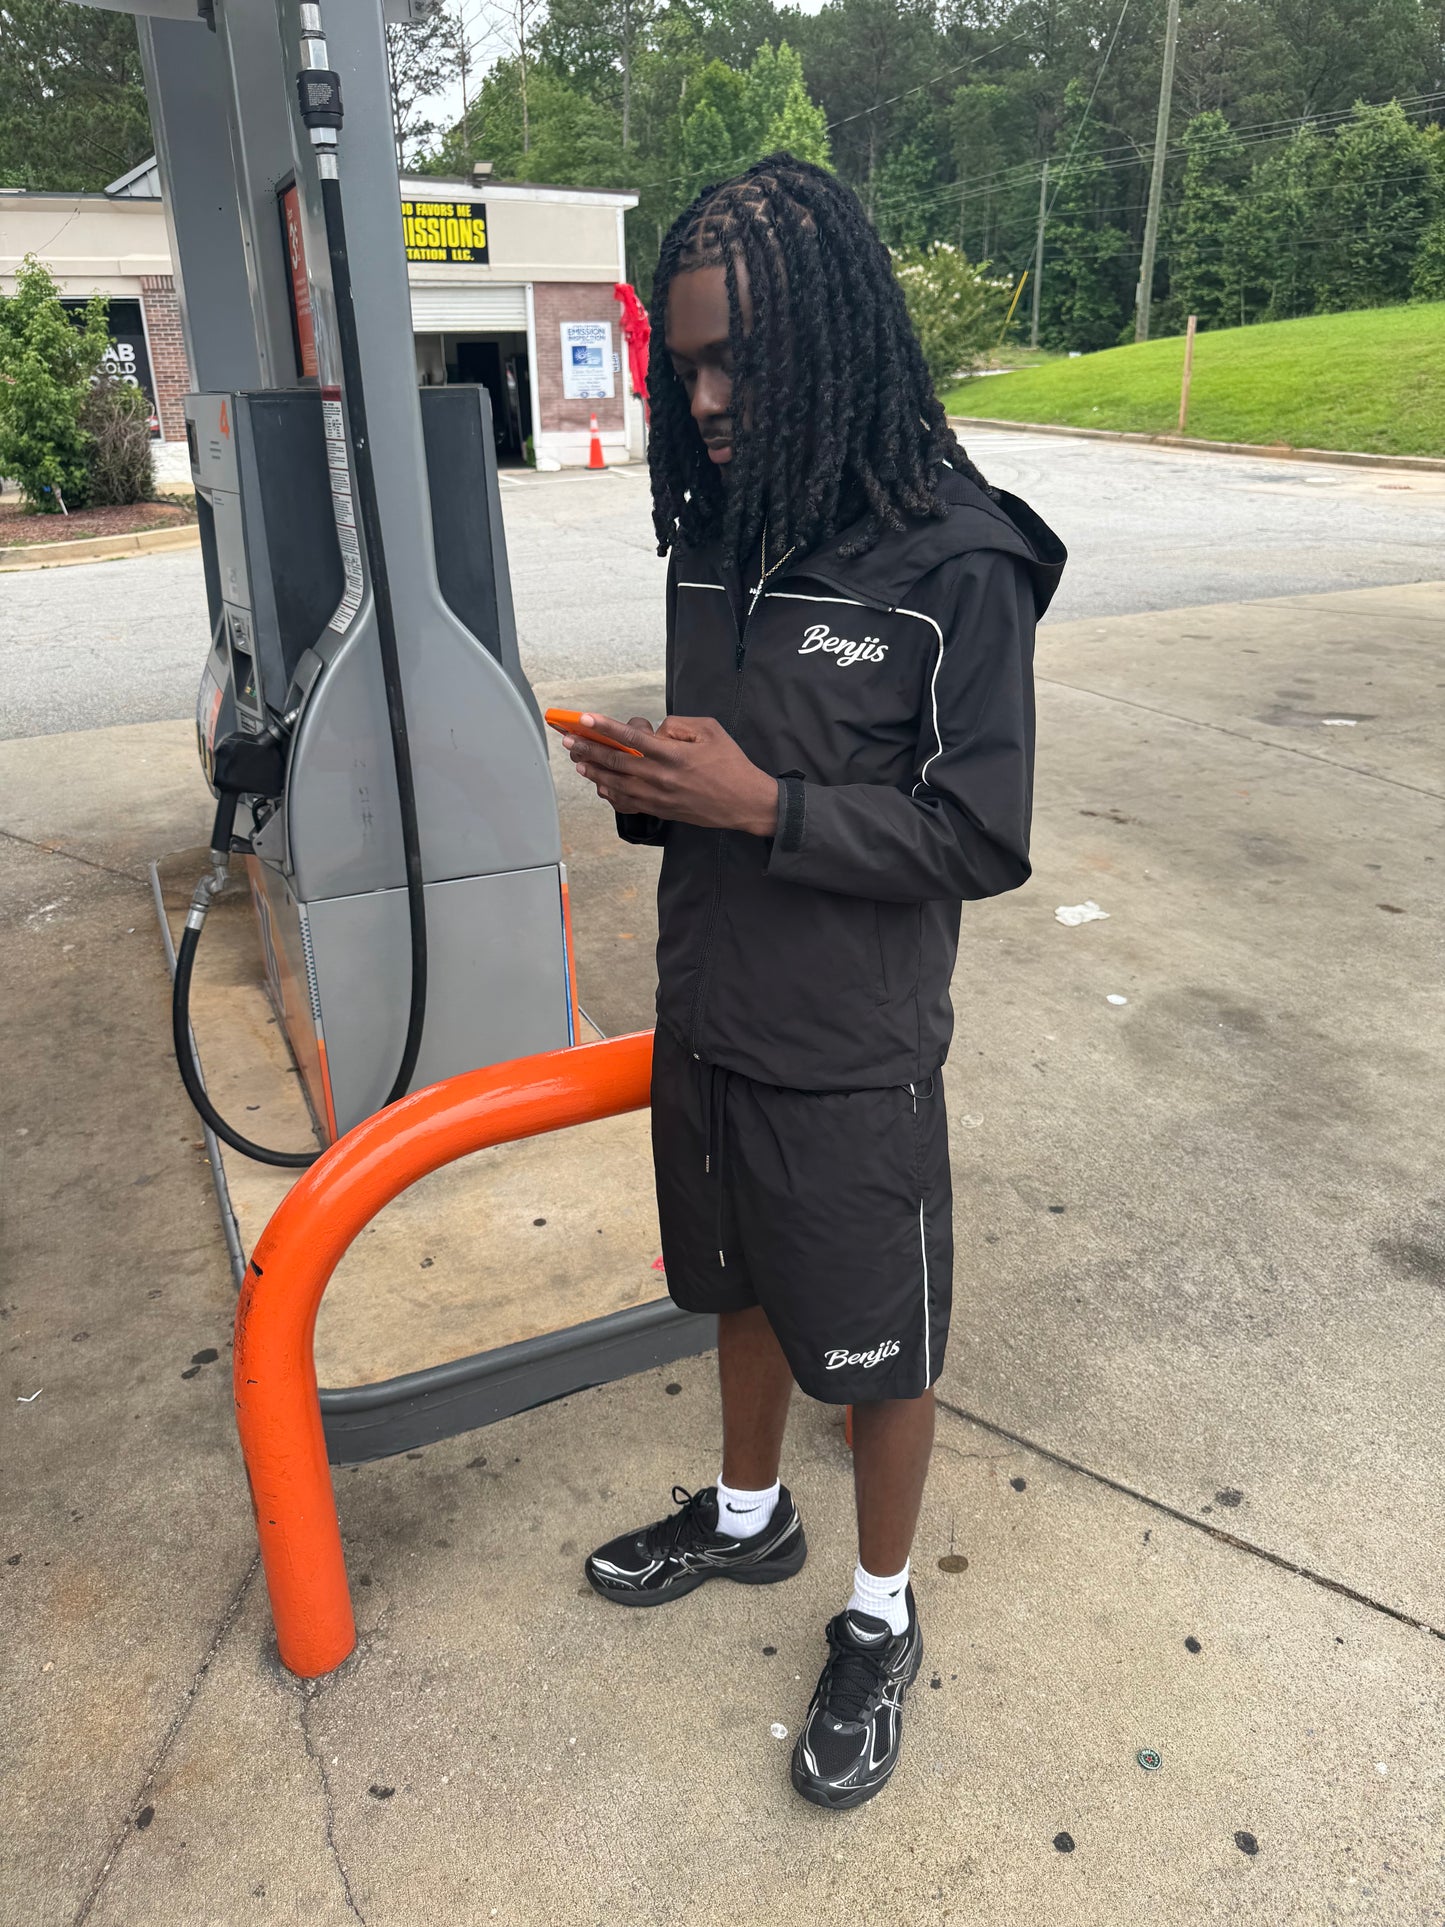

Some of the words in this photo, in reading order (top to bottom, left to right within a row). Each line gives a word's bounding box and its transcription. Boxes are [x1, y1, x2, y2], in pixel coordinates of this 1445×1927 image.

[416, 203, 454, 216] FAVORS
[456, 204, 472, 217] ME
[406, 248, 447, 260] TATION
[219, 400, 230, 440] 4
[798, 624, 889, 667] Benjis
[824, 1340, 901, 1370] Benjis
